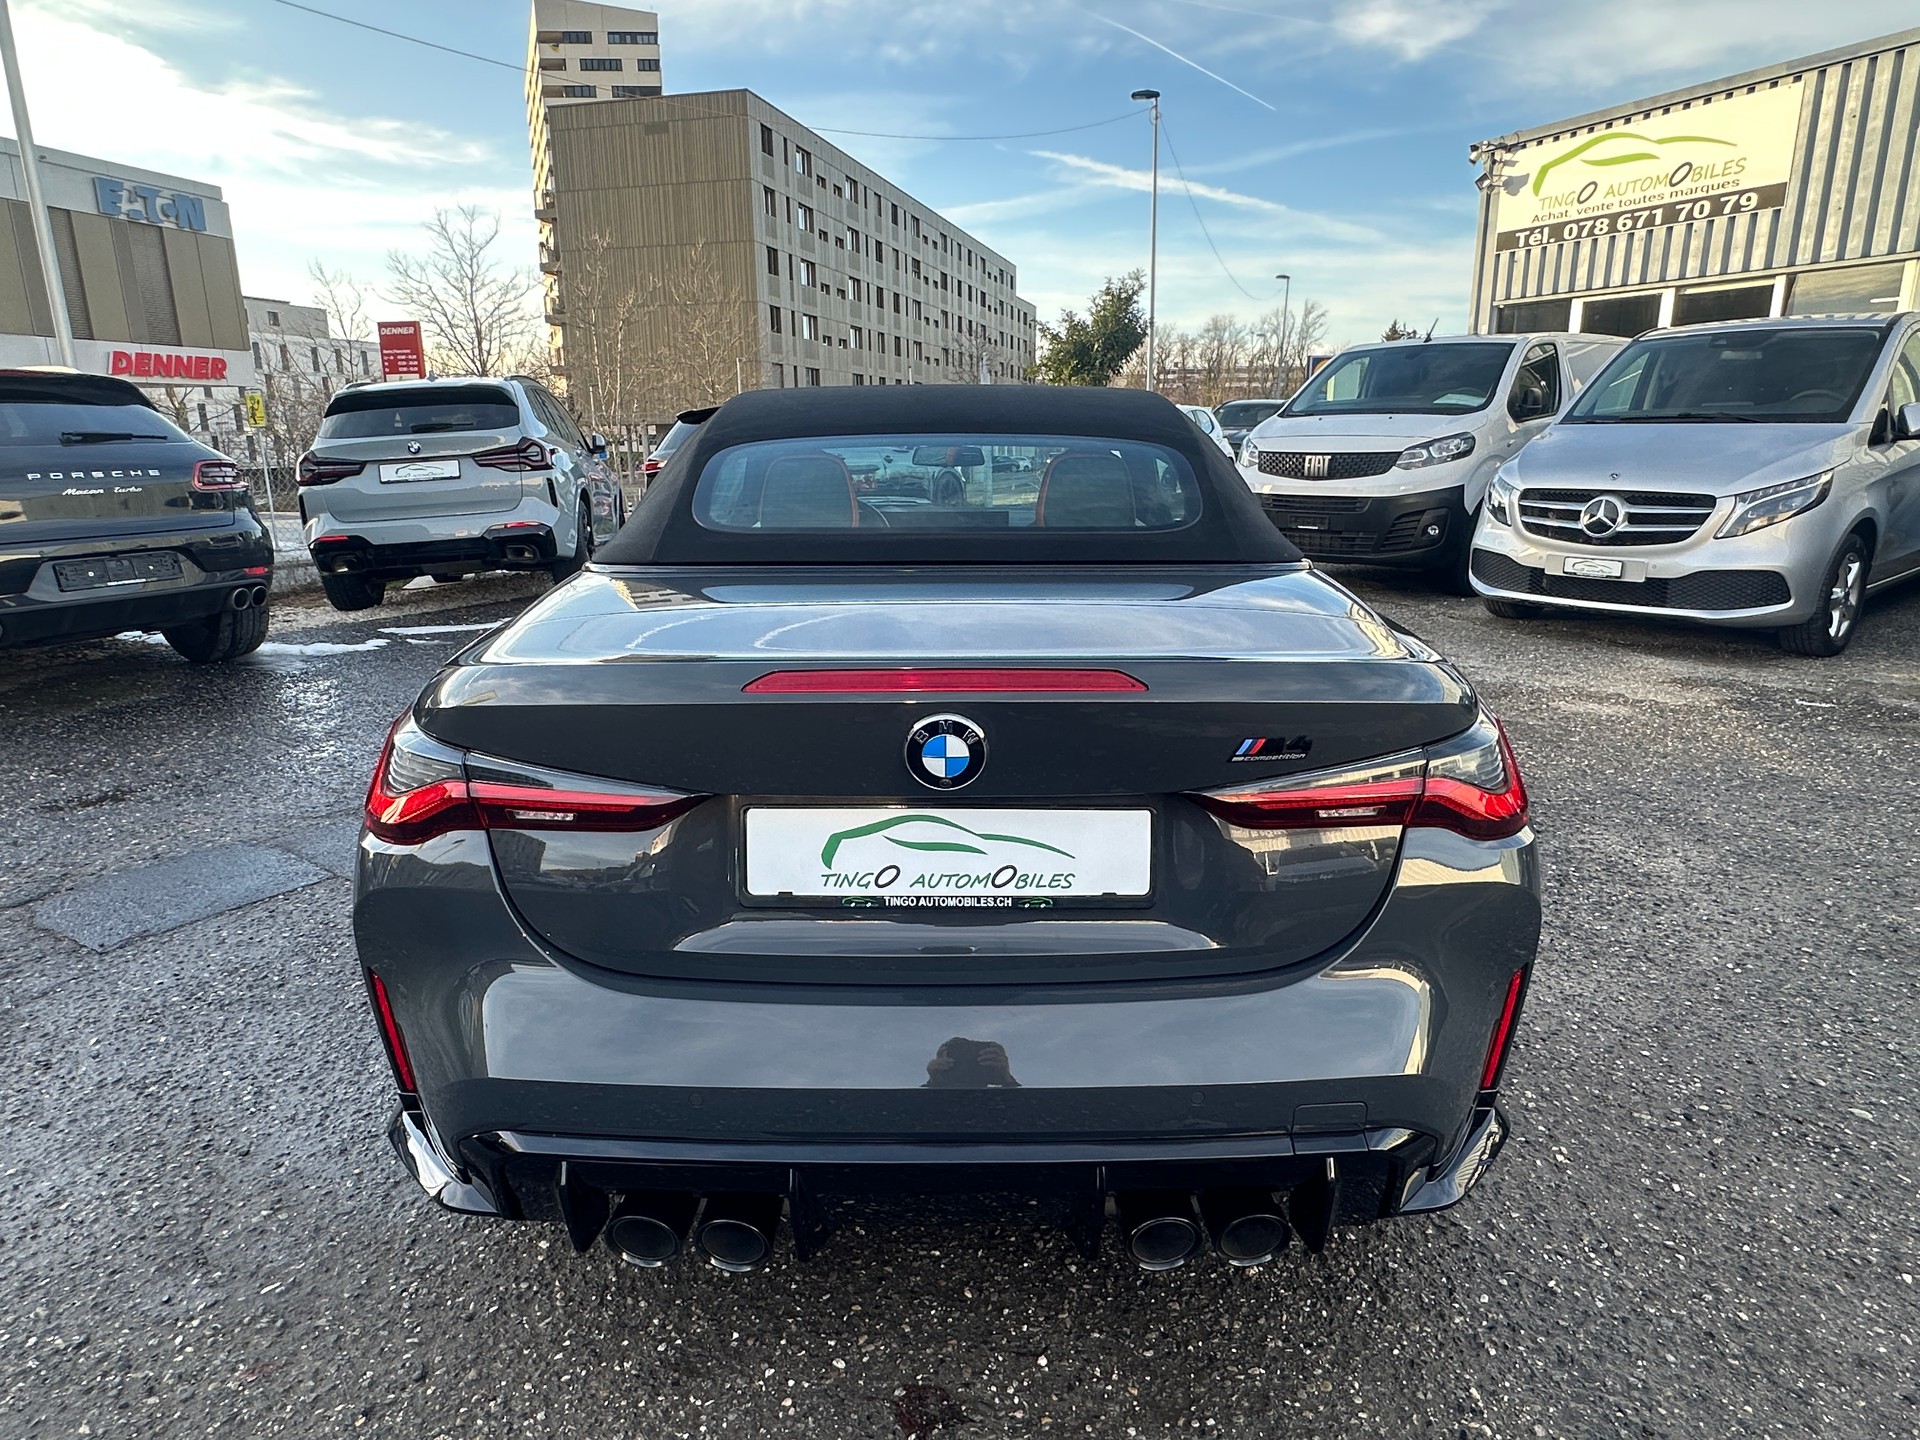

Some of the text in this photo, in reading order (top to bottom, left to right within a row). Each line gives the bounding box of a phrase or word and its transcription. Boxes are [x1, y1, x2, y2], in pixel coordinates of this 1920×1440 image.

[1539, 157, 1747, 211] TINGO AUTOMOBILES
[1576, 201, 1615, 216] vente
[1618, 192, 1665, 209] toutes
[1669, 178, 1740, 200] marques
[93, 176, 207, 232] EATON
[1515, 191, 1759, 249] Tél. 078 671 70 79
[380, 326, 415, 335] DENNER
[108, 350, 228, 380] DENNER
[26, 469, 161, 481] PORSCHE
[1304, 455, 1332, 477] FIAT
[62, 488, 105, 496] Macan
[913, 720, 980, 745] BMW
[820, 863, 1076, 891] TINGO AUTOMOBILES
[883, 896, 1013, 908] TINGO AUTOMOBILES.CH
